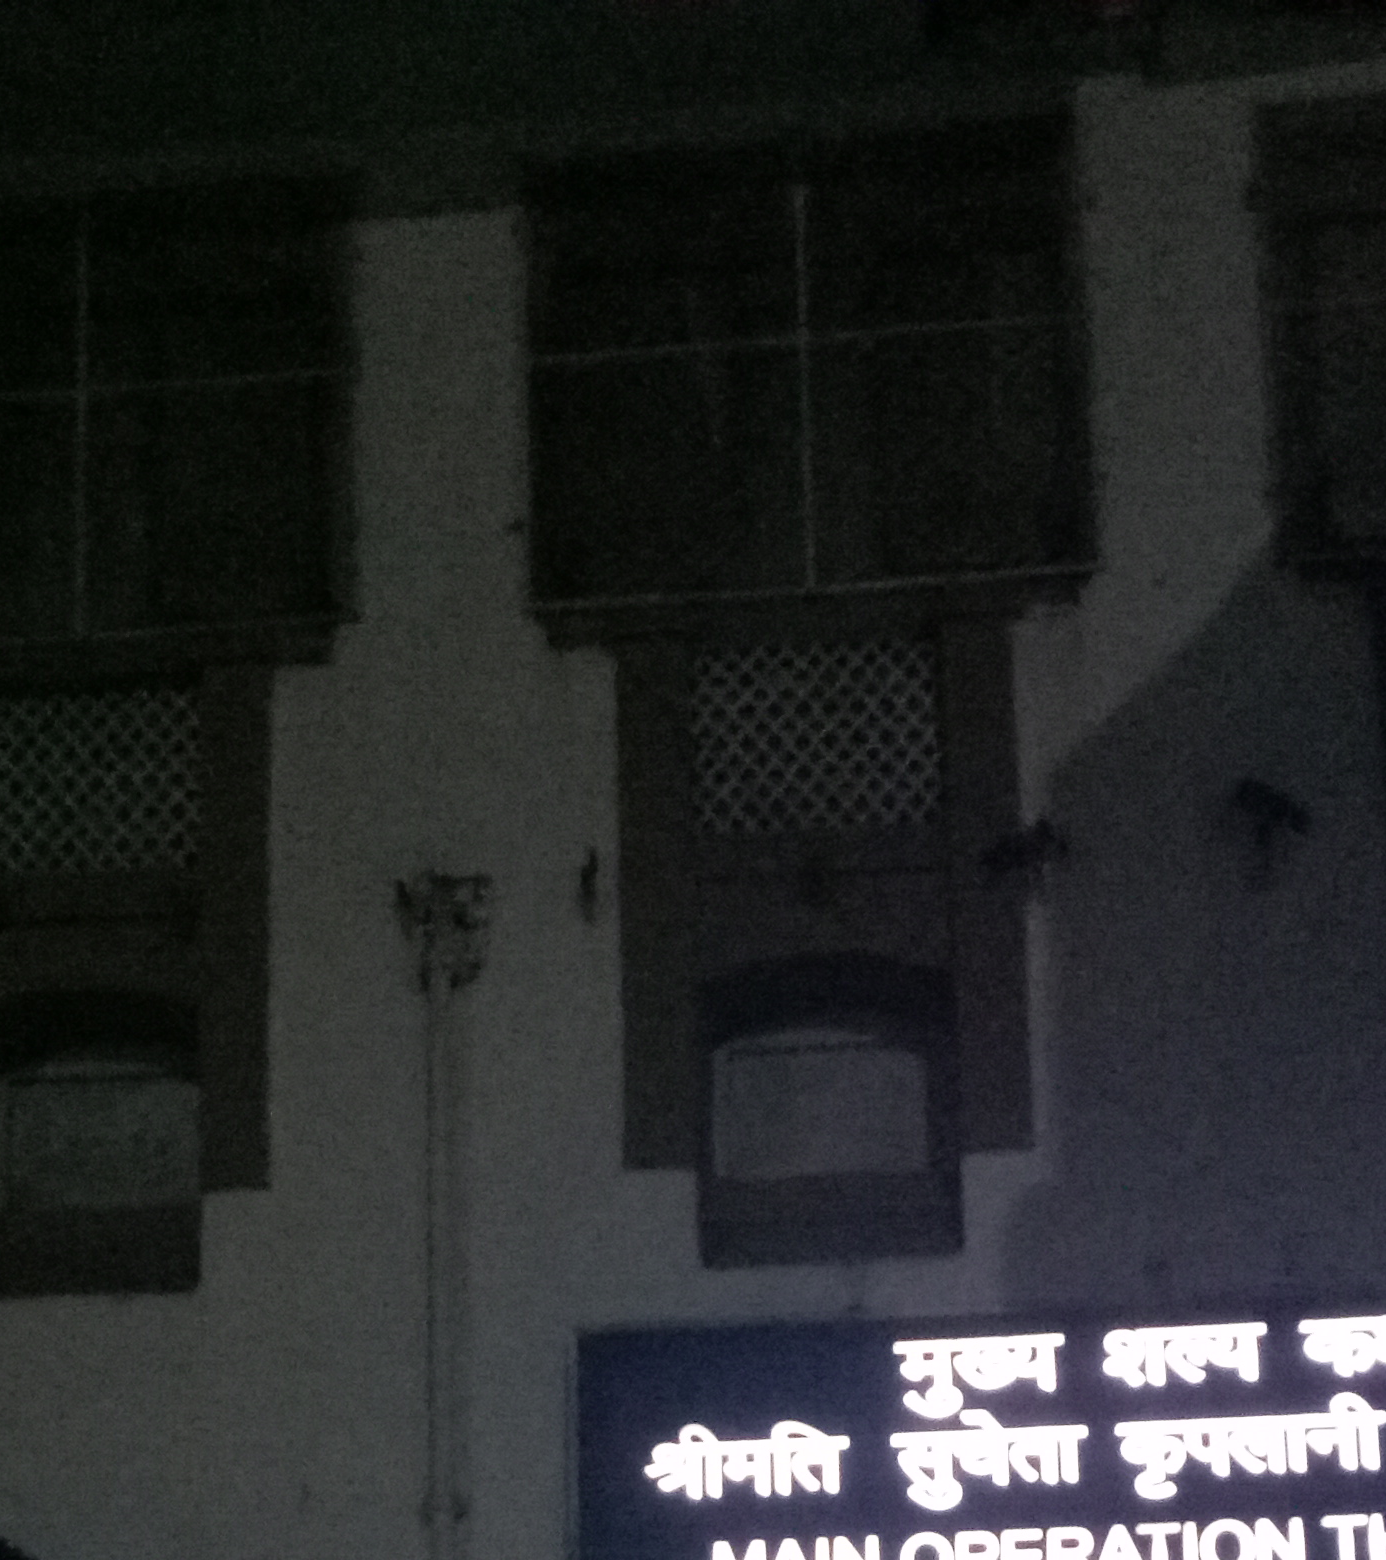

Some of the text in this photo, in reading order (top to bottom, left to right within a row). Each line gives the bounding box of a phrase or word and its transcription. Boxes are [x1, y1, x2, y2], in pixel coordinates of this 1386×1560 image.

[893, 1333, 1065, 1419] मुख्य
[1102, 1322, 1267, 1389] शल्य
[644, 1420, 850, 1502] श्रीमति
[889, 1408, 1089, 1511] सुचेता
